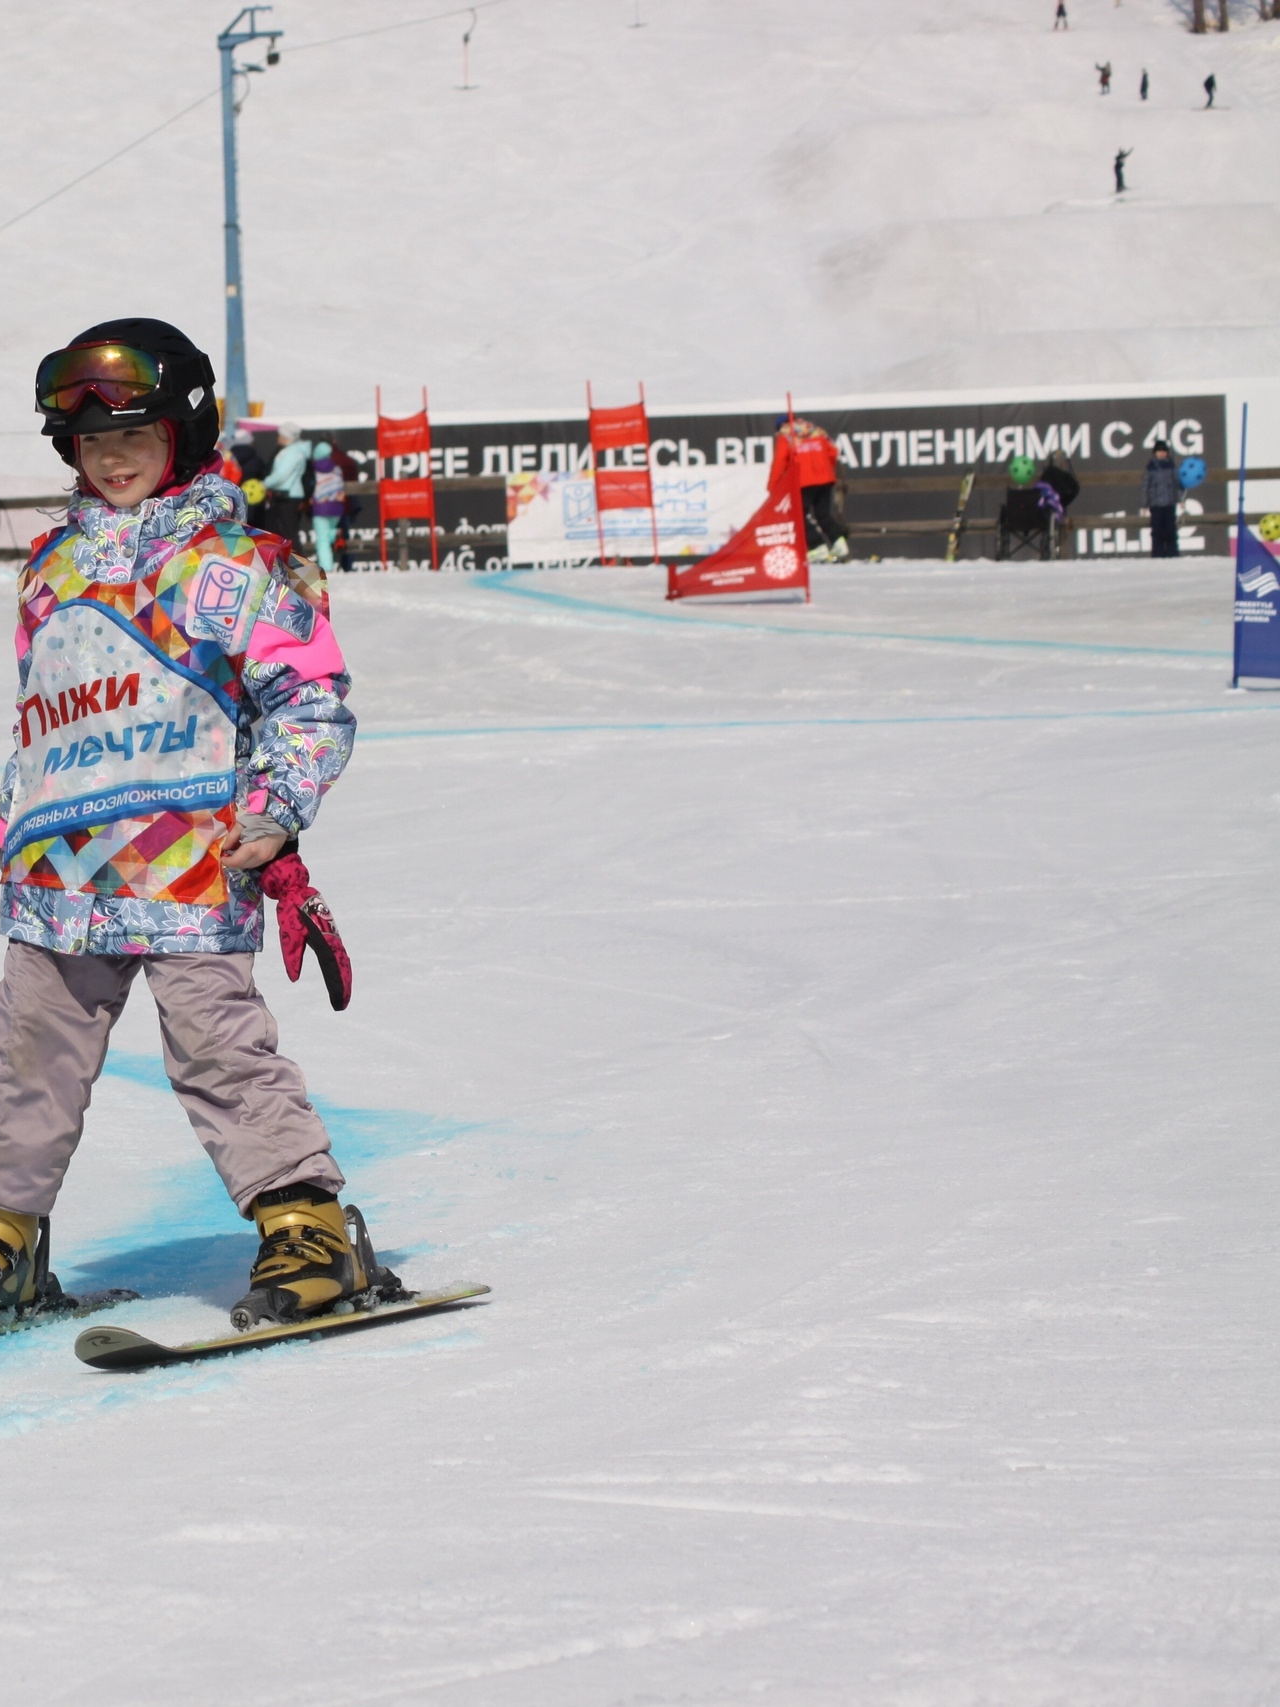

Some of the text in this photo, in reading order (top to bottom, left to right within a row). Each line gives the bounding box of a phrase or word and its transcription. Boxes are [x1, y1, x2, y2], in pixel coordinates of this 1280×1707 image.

[716, 422, 1090, 470] ВПАТЛЕНИЯМИ
[1142, 418, 1204, 456] 4G
[23, 804, 79, 835] РАВНЫХ
[82, 777, 229, 815] ВОЗМОЖНОСТЕЙ
